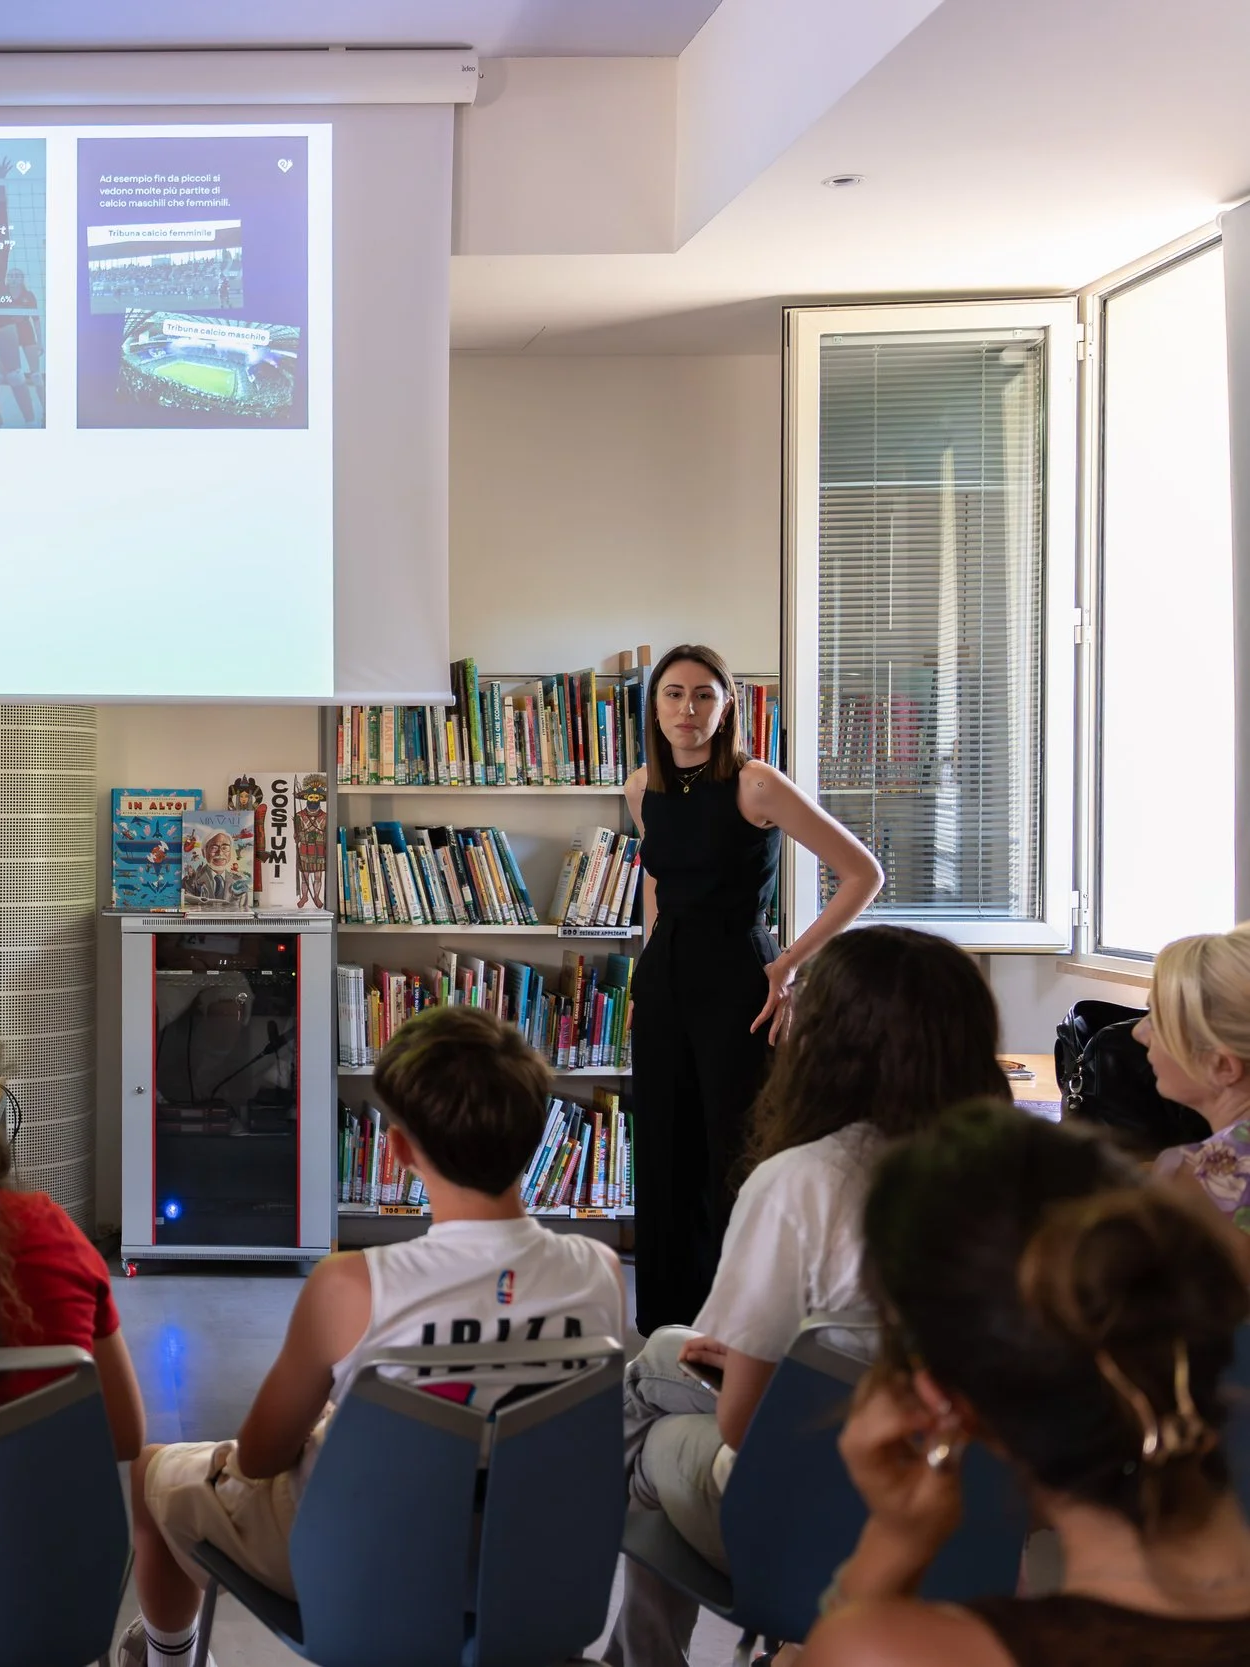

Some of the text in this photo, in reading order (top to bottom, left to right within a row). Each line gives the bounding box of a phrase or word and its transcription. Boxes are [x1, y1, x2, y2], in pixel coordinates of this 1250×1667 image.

[100, 174, 112, 182] Ad
[113, 174, 152, 184] esempio
[154, 174, 166, 182] fin
[167, 174, 179, 182] da
[180, 174, 212, 184] piccoli
[100, 186, 220, 196] vedono molte più partite di
[99, 198, 231, 208] calcio maschili che femminili.
[108, 229, 212, 238] Tribuna calcio femminile
[166, 324, 266, 342] Tribuna calcio maschile
[128, 802, 142, 810] IN
[271, 780, 288, 878] COSTUMI
